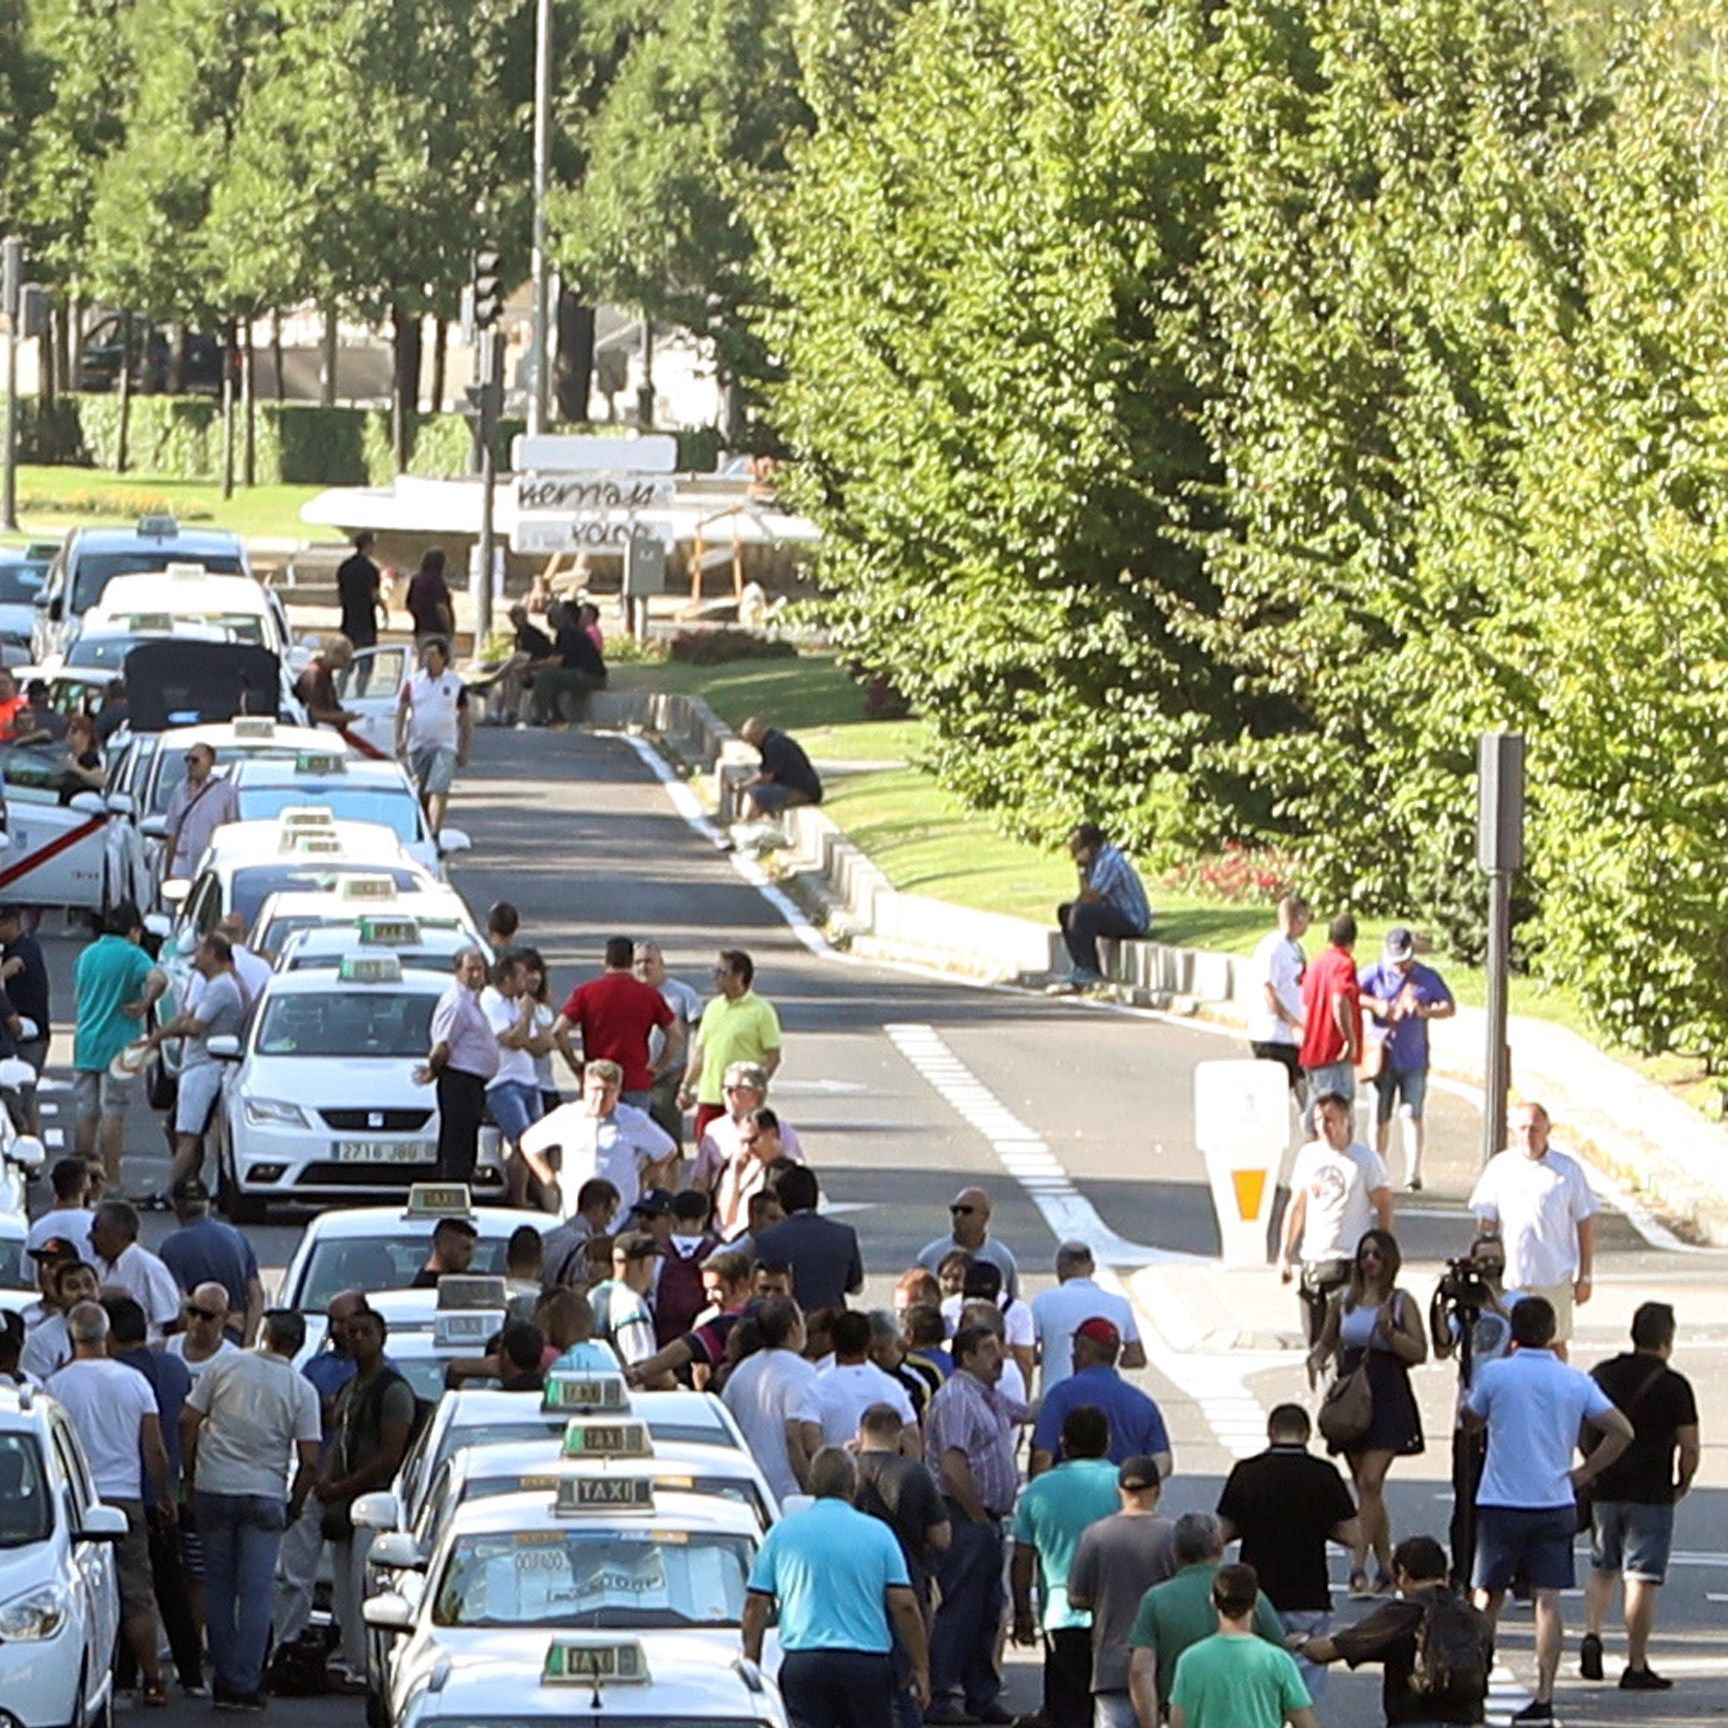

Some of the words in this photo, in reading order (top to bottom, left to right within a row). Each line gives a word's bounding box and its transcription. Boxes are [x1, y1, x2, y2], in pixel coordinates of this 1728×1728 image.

[567, 1382, 599, 1401] TAXI
[587, 1428, 620, 1448] TAXI
[580, 1481, 630, 1501] TAXI
[570, 1649, 614, 1671] TAXI
